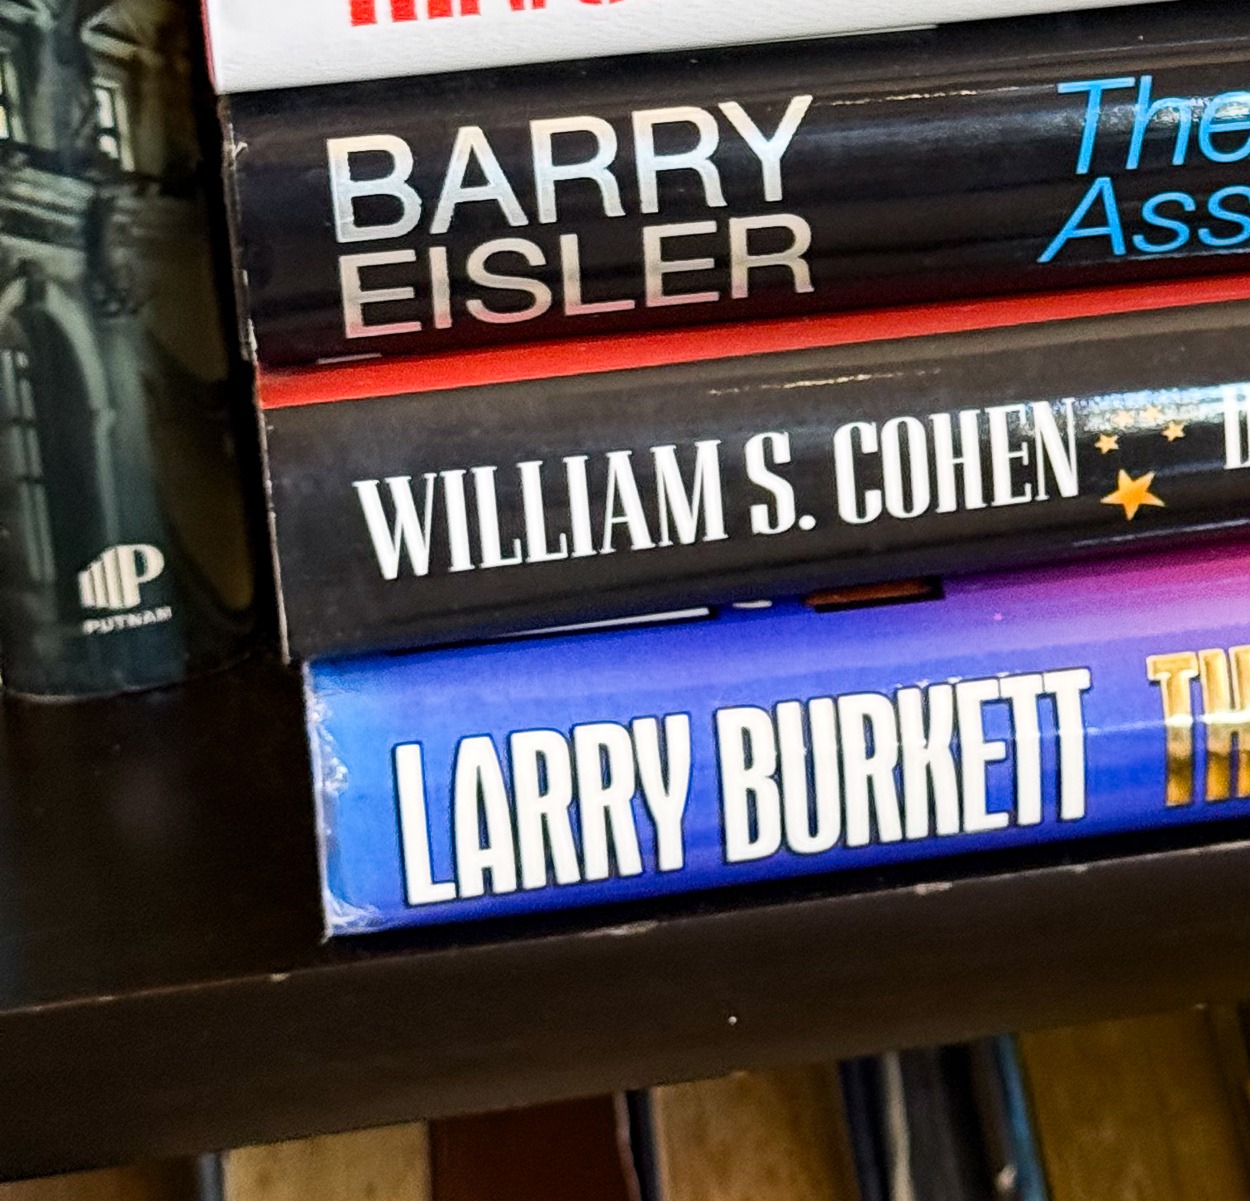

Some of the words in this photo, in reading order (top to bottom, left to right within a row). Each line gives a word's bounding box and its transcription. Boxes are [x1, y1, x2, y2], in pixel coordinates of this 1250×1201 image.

[326, 94, 813, 243] BARRY
[338, 212, 815, 339] EISLER
[351, 438, 729, 581] WILLIAM
[744, 430, 817, 536] S.
[832, 397, 1080, 526] COHEN
[81, 606, 173, 636] PUTNAM
[393, 710, 691, 907] LARRY
[714, 665, 1093, 865] BURKETT
